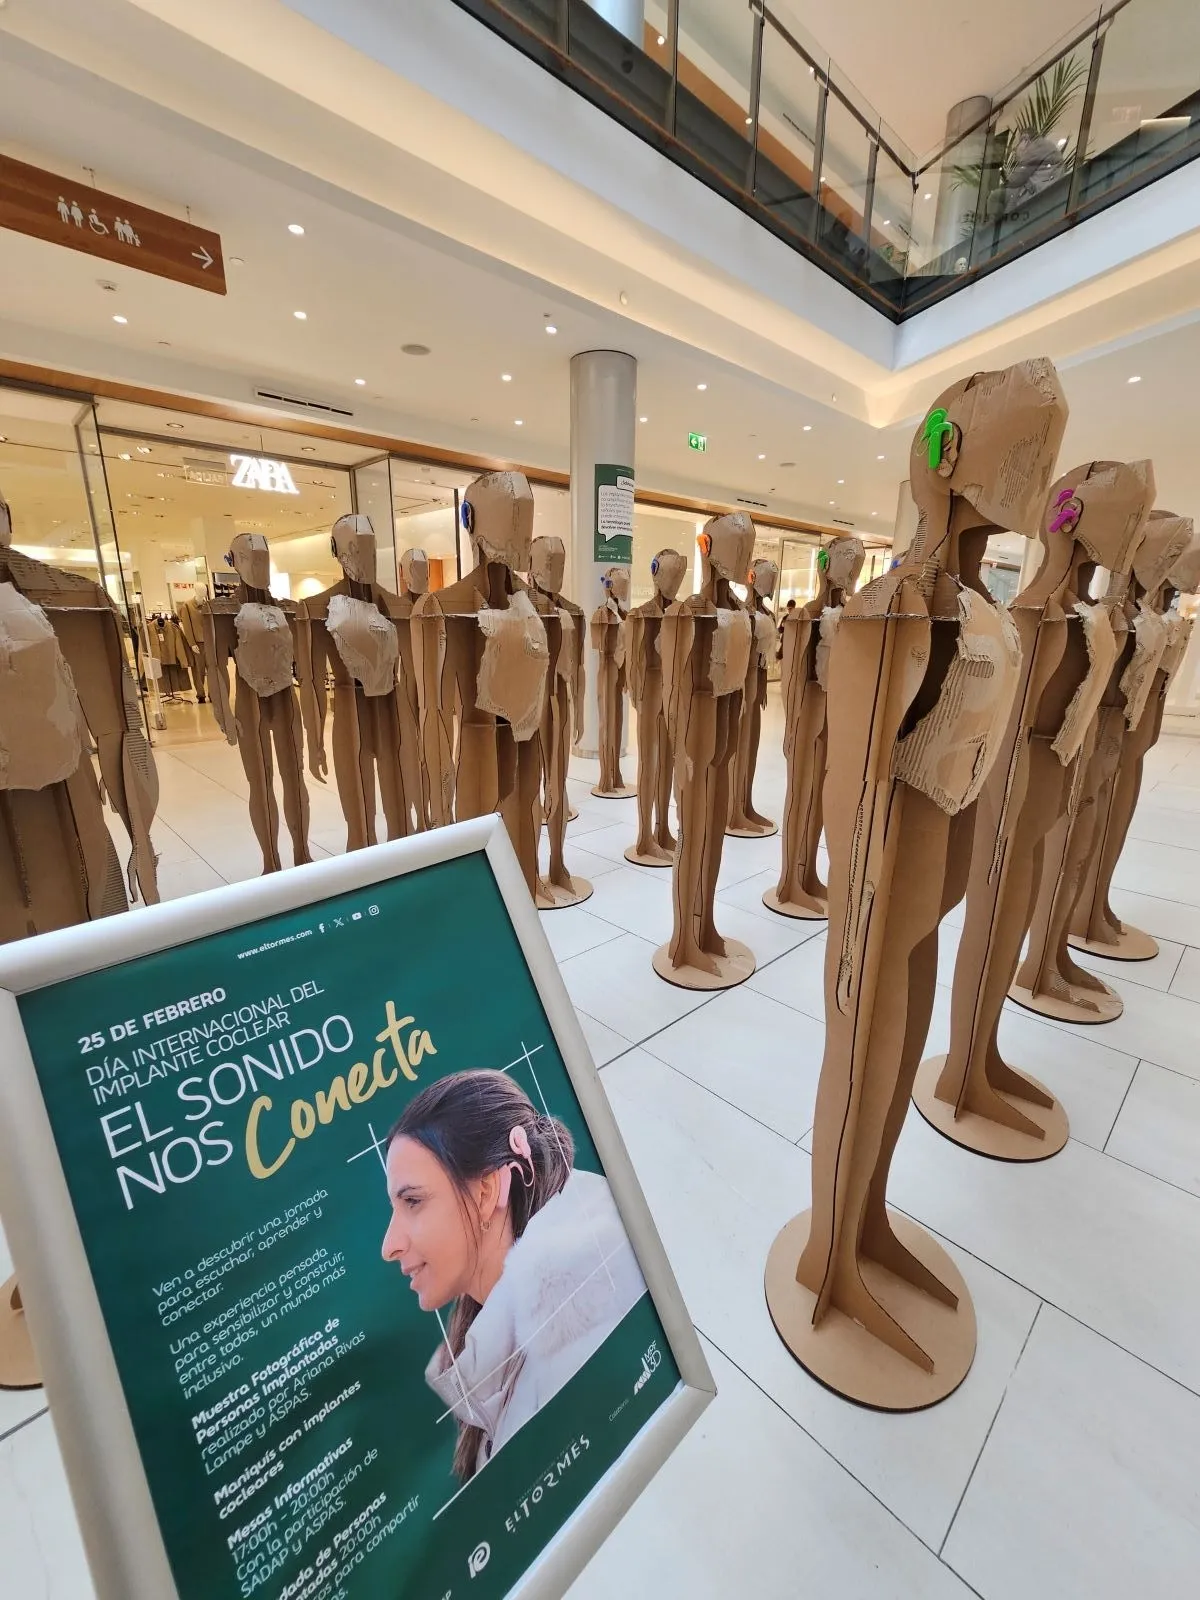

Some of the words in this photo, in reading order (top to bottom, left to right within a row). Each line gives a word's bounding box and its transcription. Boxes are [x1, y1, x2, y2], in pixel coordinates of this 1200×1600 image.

[230, 454, 300, 494] ZARA
[237, 929, 313, 960] www.eltormes.com
[77, 1031, 106, 1054] 25
[109, 1019, 140, 1043] DE
[142, 987, 227, 1030] FEBRERO
[86, 1056, 129, 1087] DÍA
[132, 993, 291, 1067] INTERNACIONAL
[289, 980, 325, 1005] DEL
[92, 1049, 204, 1105] IMPLANTE
[206, 1011, 291, 1057] COCLEAR
[99, 1101, 174, 1160] EL
[177, 1014, 354, 1121] SONIDO
[116, 1120, 234, 1211] NOS
[245, 1000, 438, 1180] Conecta
[152, 1276, 182, 1297] Ven
[184, 1269, 195, 1280] a
[197, 1231, 255, 1272] descubrir
[258, 1216, 283, 1236] una
[284, 1188, 329, 1223] jornada
[157, 1286, 193, 1316] para
[195, 1248, 256, 1289] escuchar,
[258, 1212, 311, 1251] aprender
[313, 1206, 323, 1219] y
[162, 1282, 224, 1327] conectar.
[169, 1330, 201, 1355] Una
[203, 1281, 277, 1334] experiencia
[279, 1248, 329, 1286] pensada
[174, 1342, 210, 1373] para
[212, 1291, 280, 1345] sensibilizar
[282, 1286, 293, 1300] y
[294, 1251, 345, 1290] construir,
[179, 1353, 217, 1385] entre
[220, 1327, 259, 1357] todos,
[261, 1312, 279, 1328] un
[280, 1283, 320, 1316] mundo
[322, 1265, 347, 1288] más
[183, 1354, 244, 1400] inclusivo.
[191, 1383, 250, 1430] Muestra
[251, 1331, 324, 1387] Fotográfica
[324, 1317, 341, 1333] de
[195, 1393, 262, 1444] Personas
[262, 1335, 339, 1396] Implantadas
[201, 1406, 266, 1460] realizado
[268, 1388, 289, 1412] por
[293, 1356, 334, 1391] Ariana
[334, 1331, 366, 1359] Rivas
[204, 1433, 253, 1476] Lampe
[255, 1424, 267, 1439] y
[269, 1388, 312, 1428] ASPAS.
[213, 1449, 277, 1506] Maniquís
[278, 1429, 302, 1452] con
[303, 1380, 362, 1431] implantes
[219, 1459, 285, 1520] cocleares
[227, 1506, 273, 1550] Mesas
[274, 1437, 353, 1510] Informativas
[231, 1521, 278, 1564] 17:00h
[289, 1471, 335, 1516] 20:00h
[236, 1553, 266, 1582] Con
[266, 1538, 283, 1555] la
[284, 1464, 363, 1543] participación
[363, 1448, 379, 1466] de
[334, 1551, 366, 1588] para
[366, 1494, 420, 1553] compartir
[340, 1514, 382, 1561] 20:00h
[240, 1547, 289, 1600] SADAP
[291, 1539, 303, 1556] y
[305, 1496, 347, 1542] ASPAS.
[278, 1566, 314, 1600] dada
[315, 1546, 332, 1567] de
[333, 1491, 387, 1550] Personas
